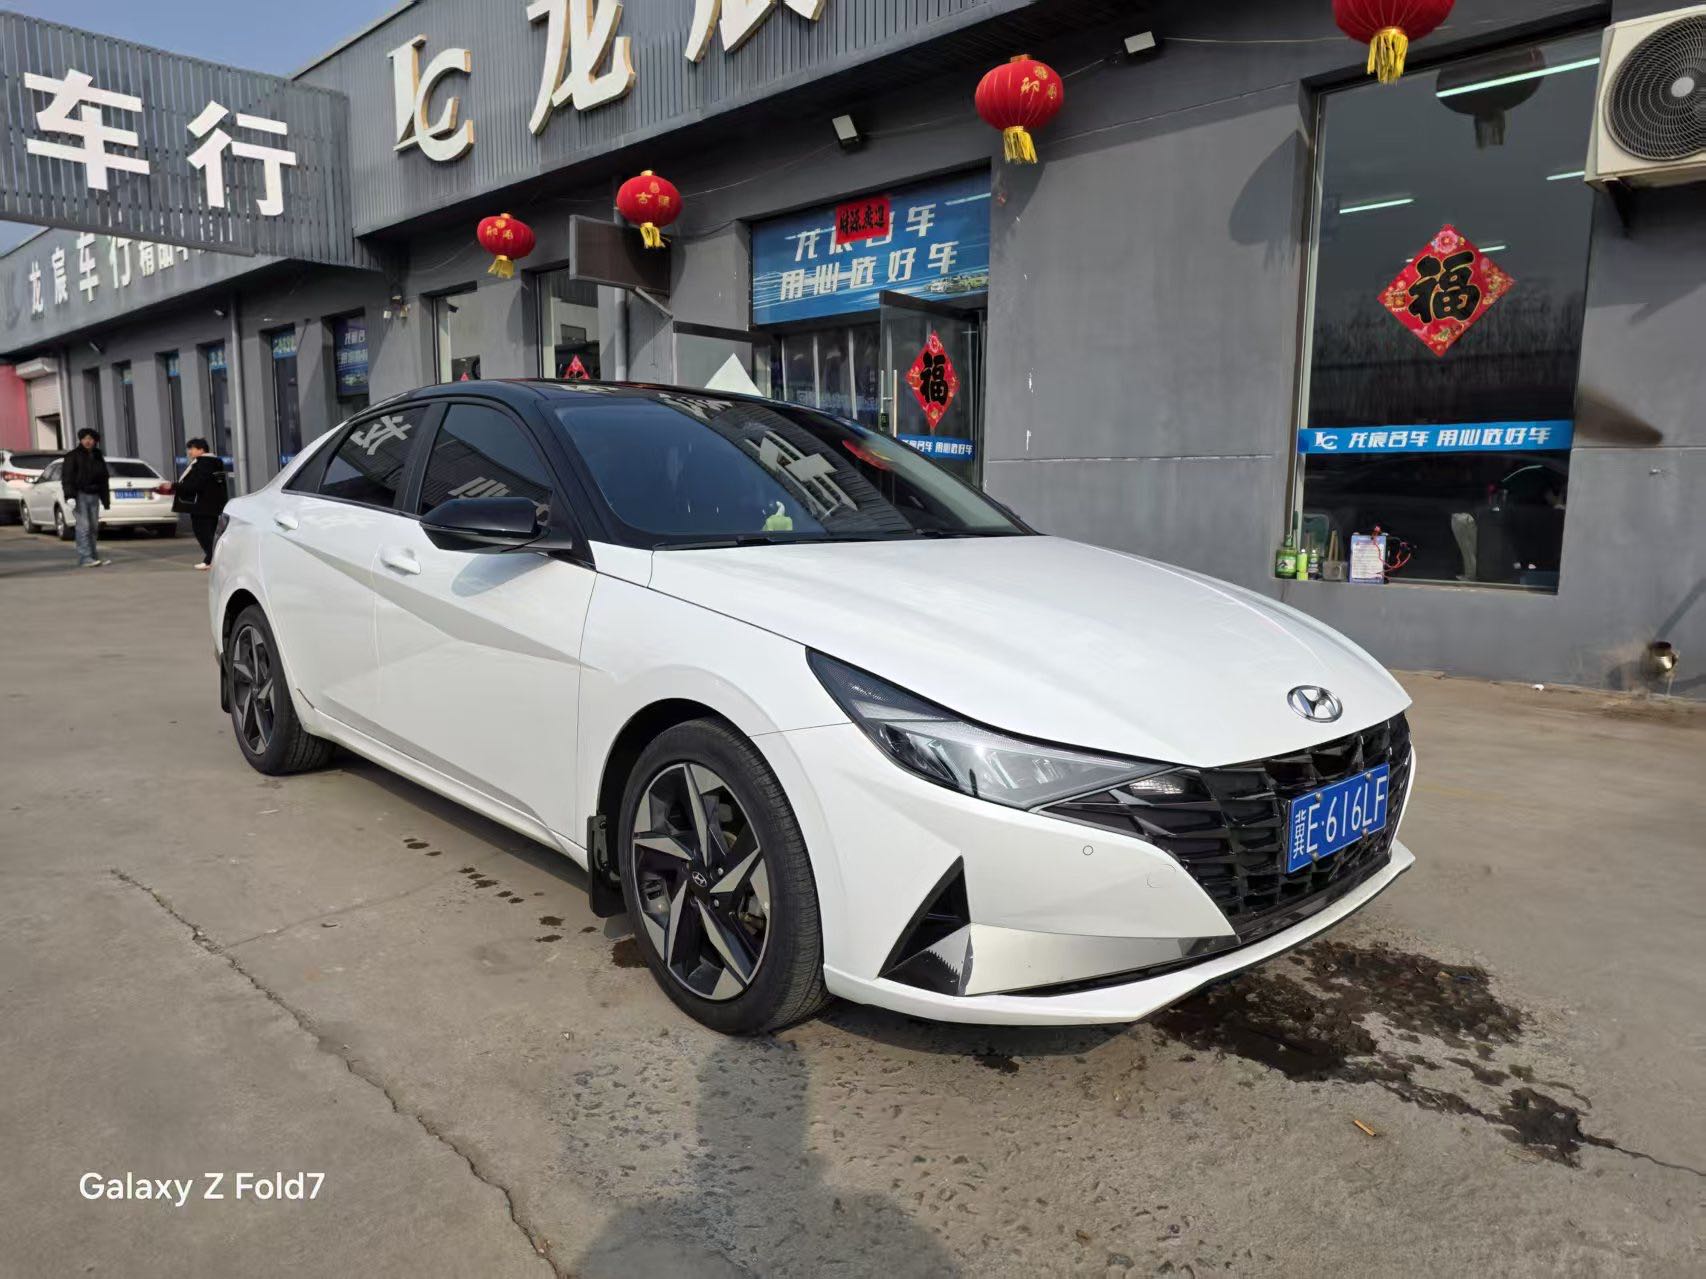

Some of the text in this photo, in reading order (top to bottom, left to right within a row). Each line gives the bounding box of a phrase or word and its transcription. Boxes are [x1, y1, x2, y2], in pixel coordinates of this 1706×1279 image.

[24, 68, 298, 217] 车行
[780, 240, 960, 301] 用心选好车
[1408, 251, 1482, 324] 福
[920, 351, 949, 406] 福
[1436, 427, 1552, 447] 用心选好车
